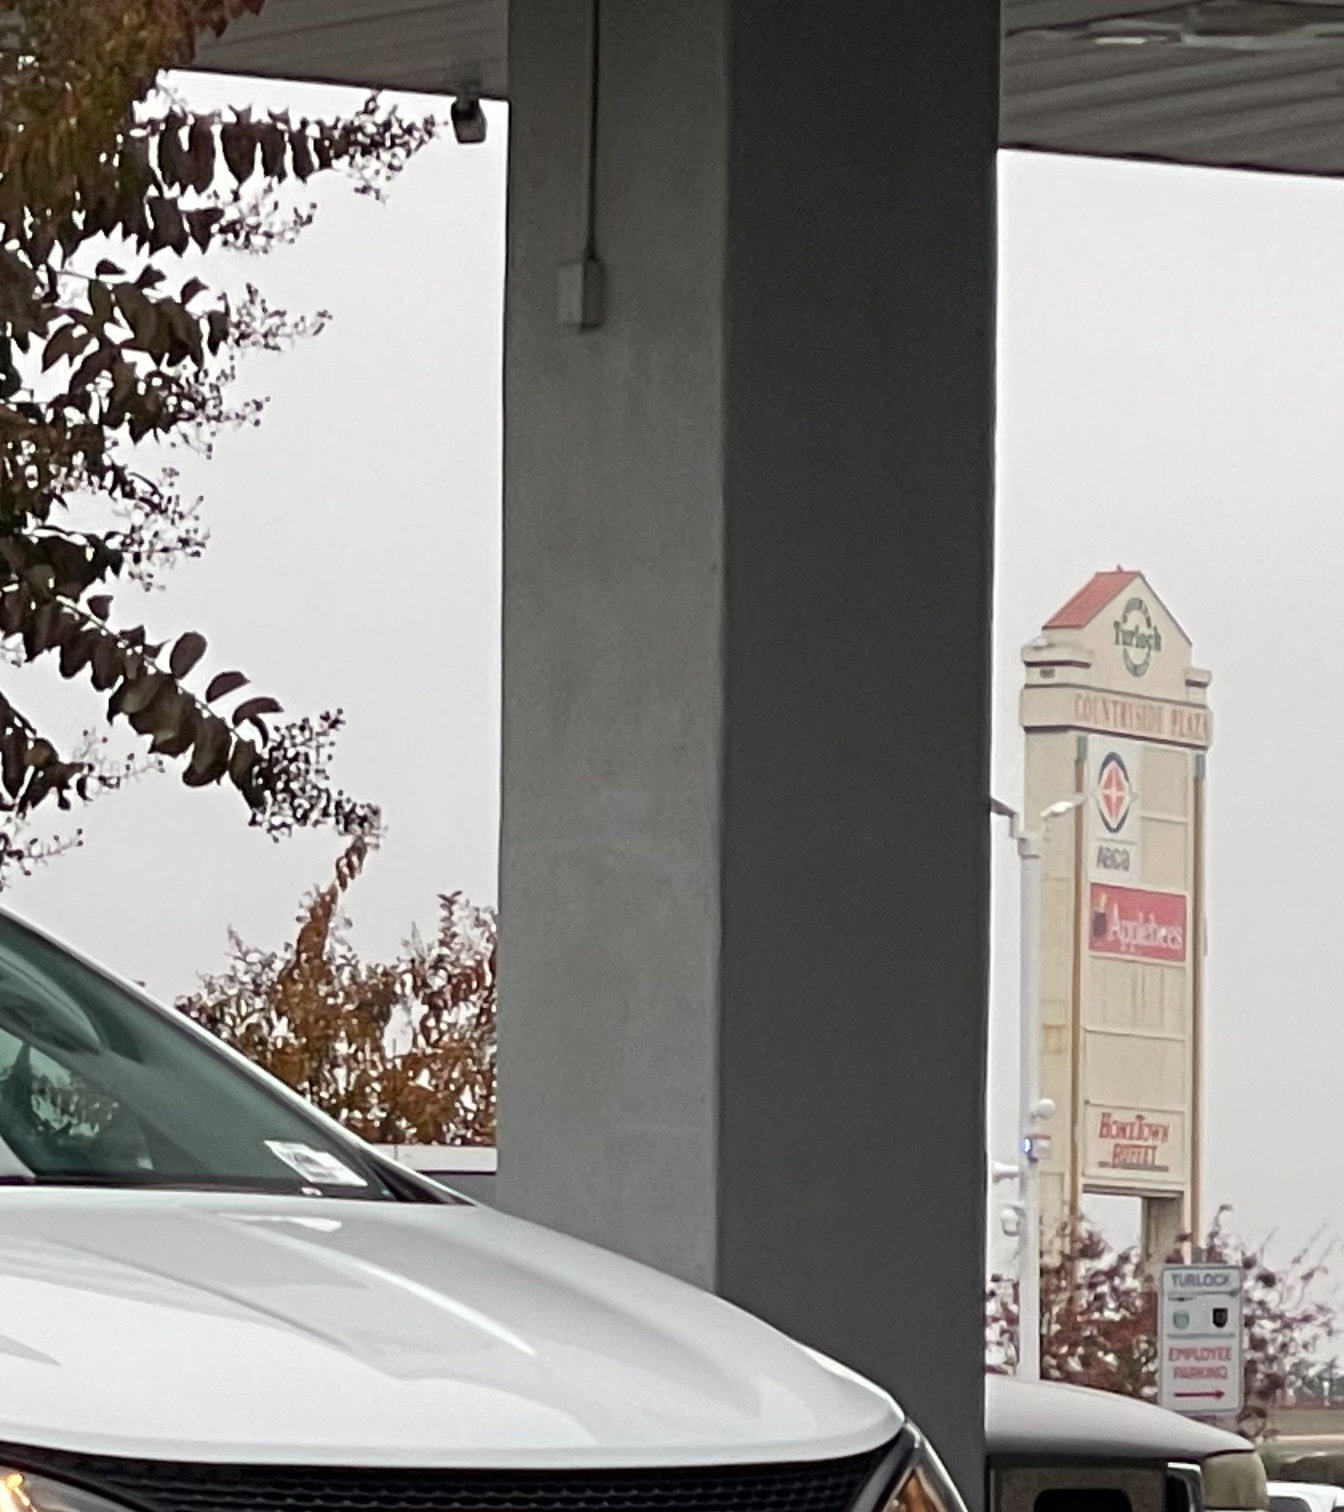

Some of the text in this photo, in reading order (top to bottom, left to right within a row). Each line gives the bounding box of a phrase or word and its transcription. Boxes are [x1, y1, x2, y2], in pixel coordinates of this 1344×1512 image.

[1171, 1273, 1231, 1288] TURLOCK
[1167, 1347, 1233, 1362] EMPLOYEE
[1173, 1366, 1229, 1380] PARKING
